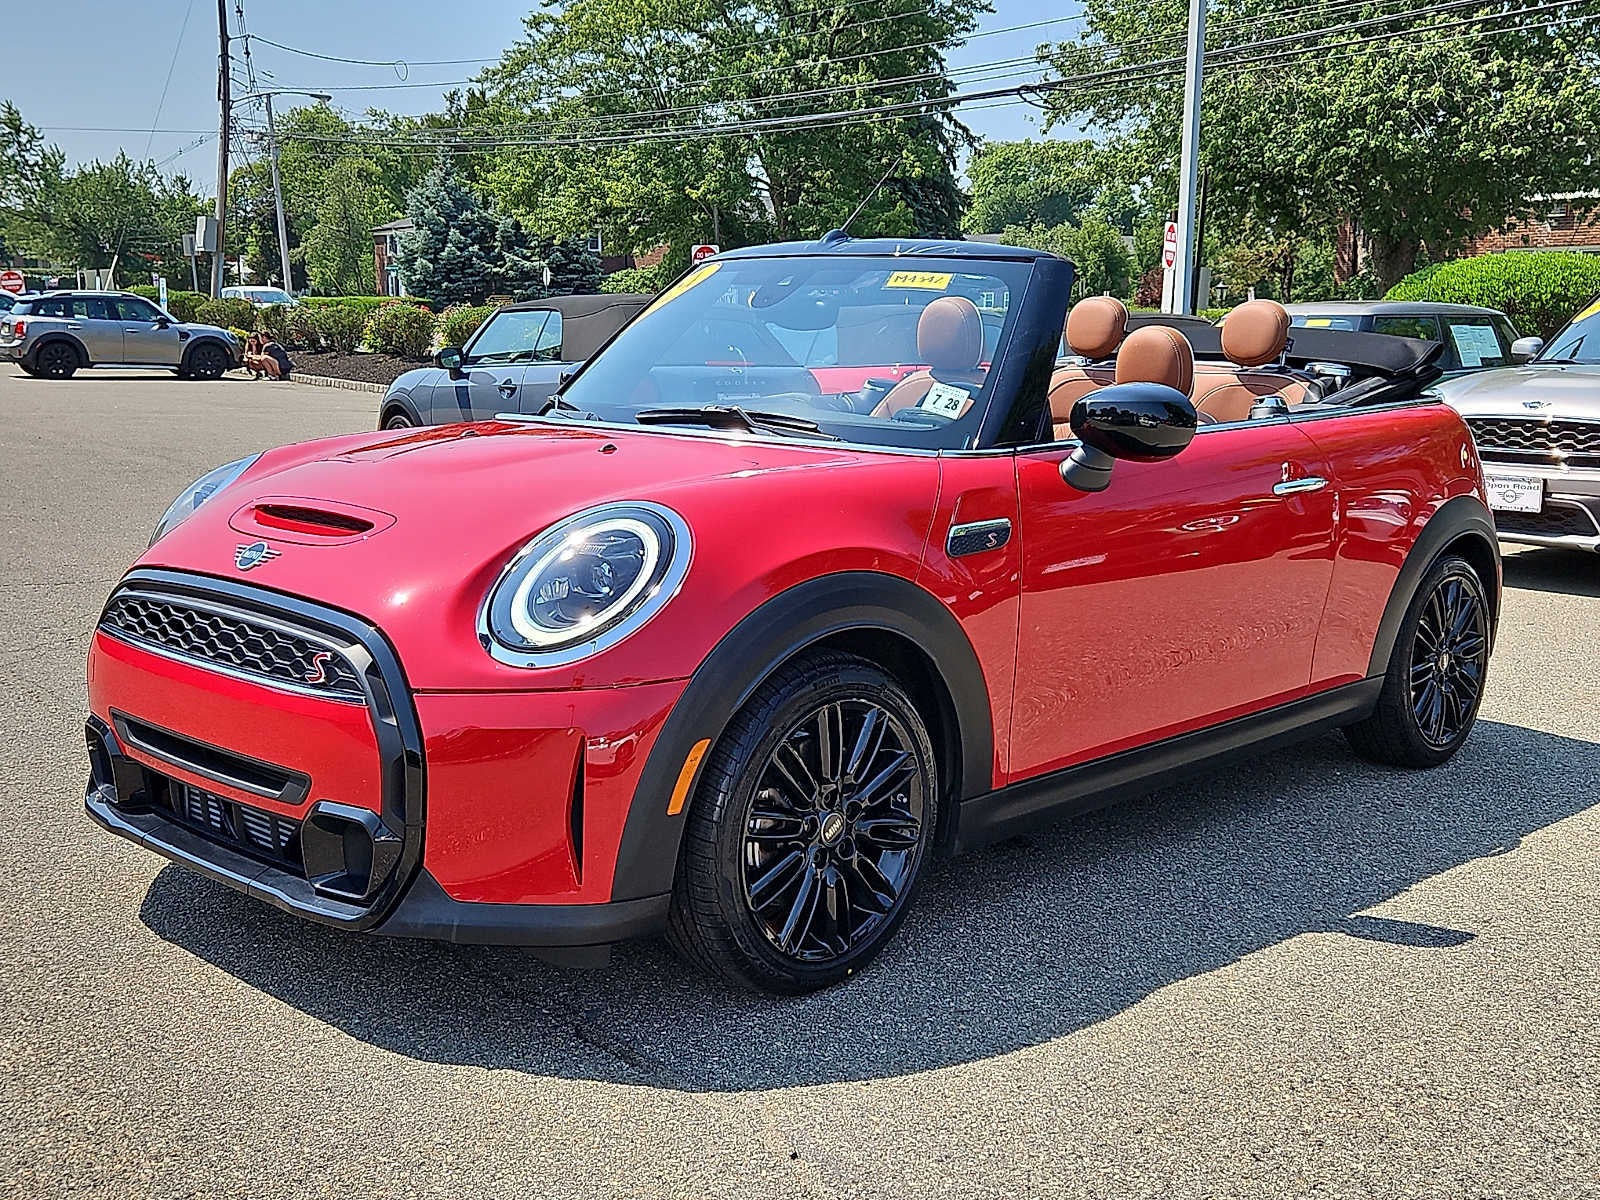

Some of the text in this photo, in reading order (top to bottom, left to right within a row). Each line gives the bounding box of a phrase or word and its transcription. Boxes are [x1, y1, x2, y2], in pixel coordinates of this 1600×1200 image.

[932, 394, 942, 405] 7
[944, 397, 960, 411] 28
[985, 532, 998, 547] S
[304, 651, 332, 684] S
[824, 818, 842, 841] MINI
